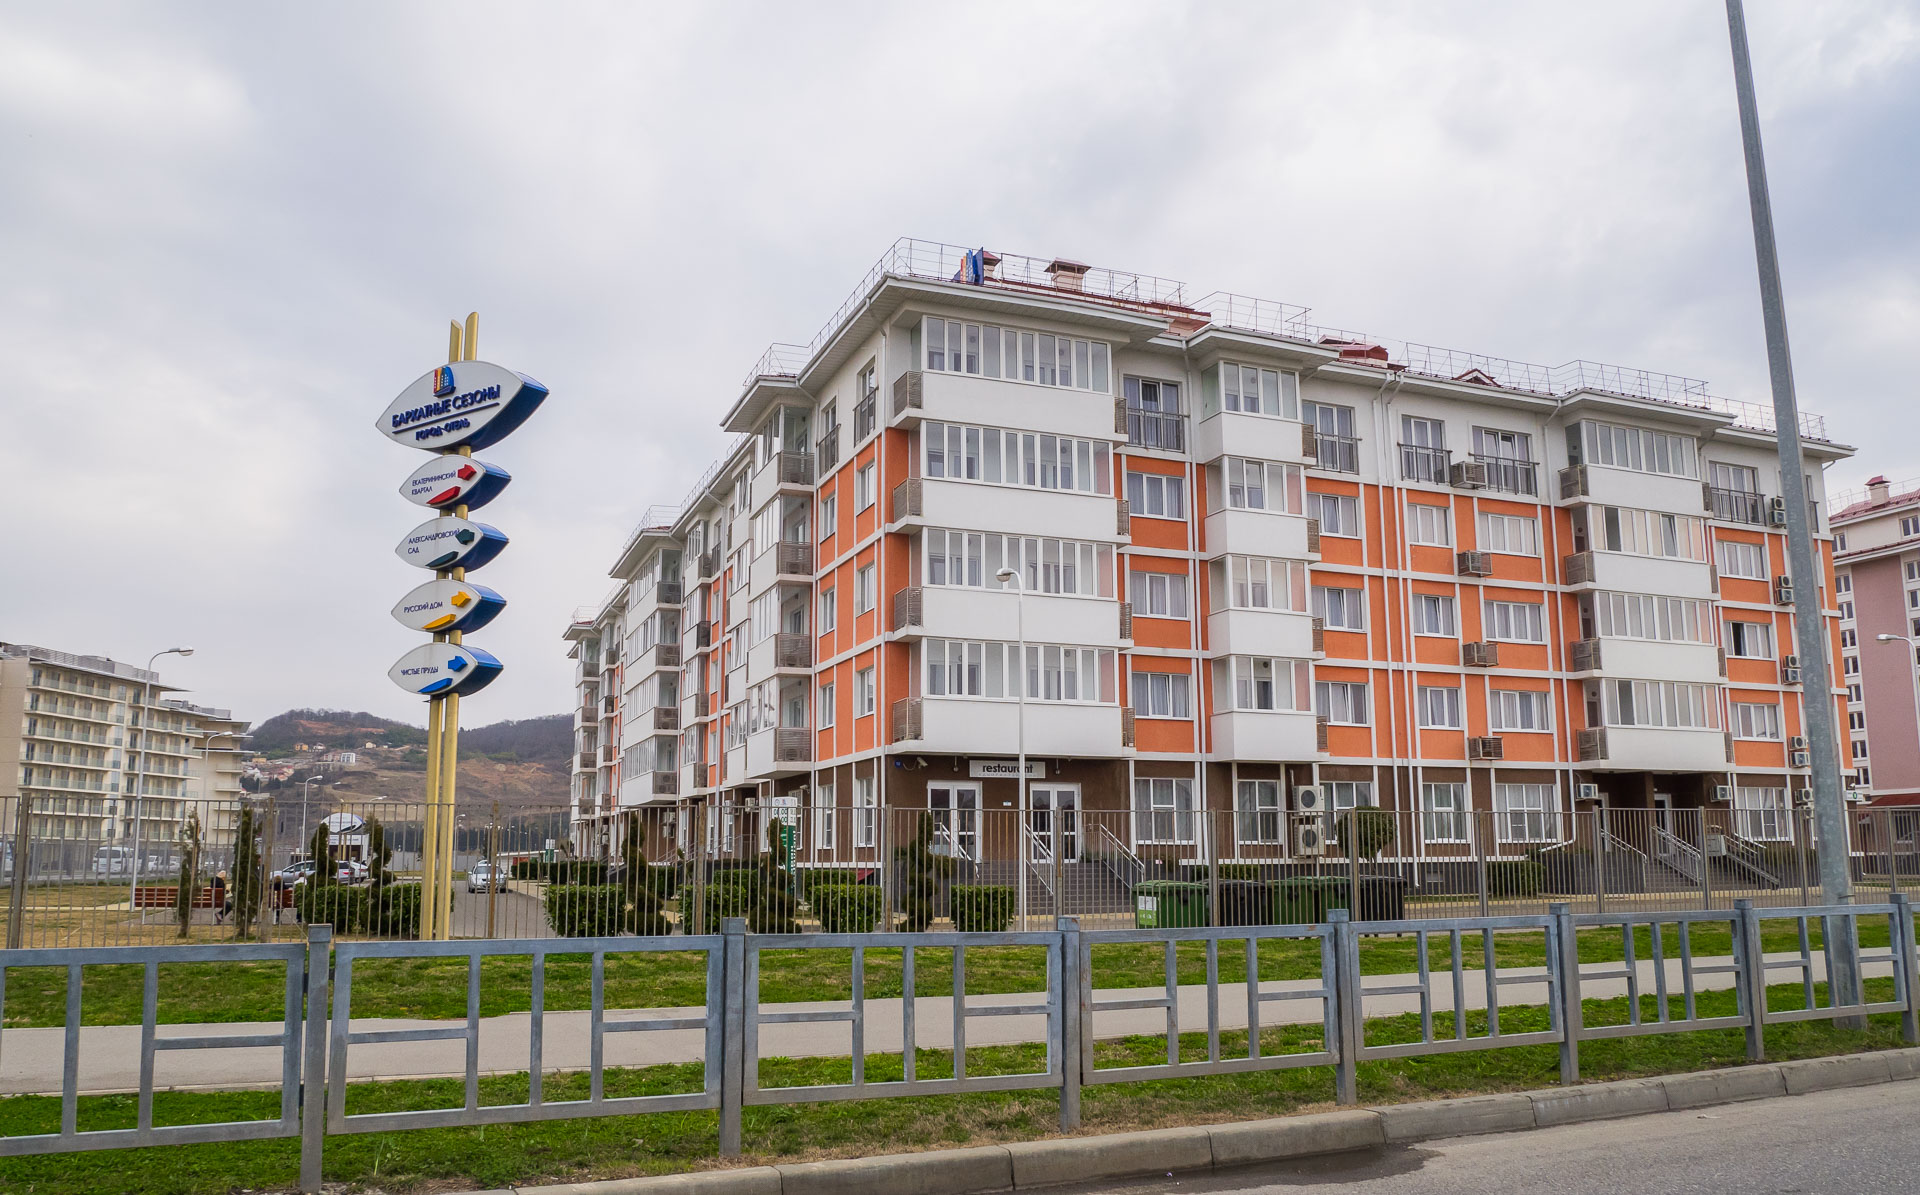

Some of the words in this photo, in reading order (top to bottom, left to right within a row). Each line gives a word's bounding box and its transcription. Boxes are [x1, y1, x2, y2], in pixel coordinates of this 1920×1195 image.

[392, 399, 451, 428] БАРХАТНЫЕ
[452, 384, 501, 410] СЕЗОНЫ
[412, 470, 457, 486] ЕКАТЕРИНИНСКИЙ
[412, 486, 432, 496] КВАРТАЛ
[408, 546, 420, 554] САД
[404, 602, 428, 613] РУССКИЙ
[430, 601, 443, 610] ДОМ
[400, 668, 420, 676] ЧИСТЫЕ
[420, 666, 438, 674] ПРУДЫ
